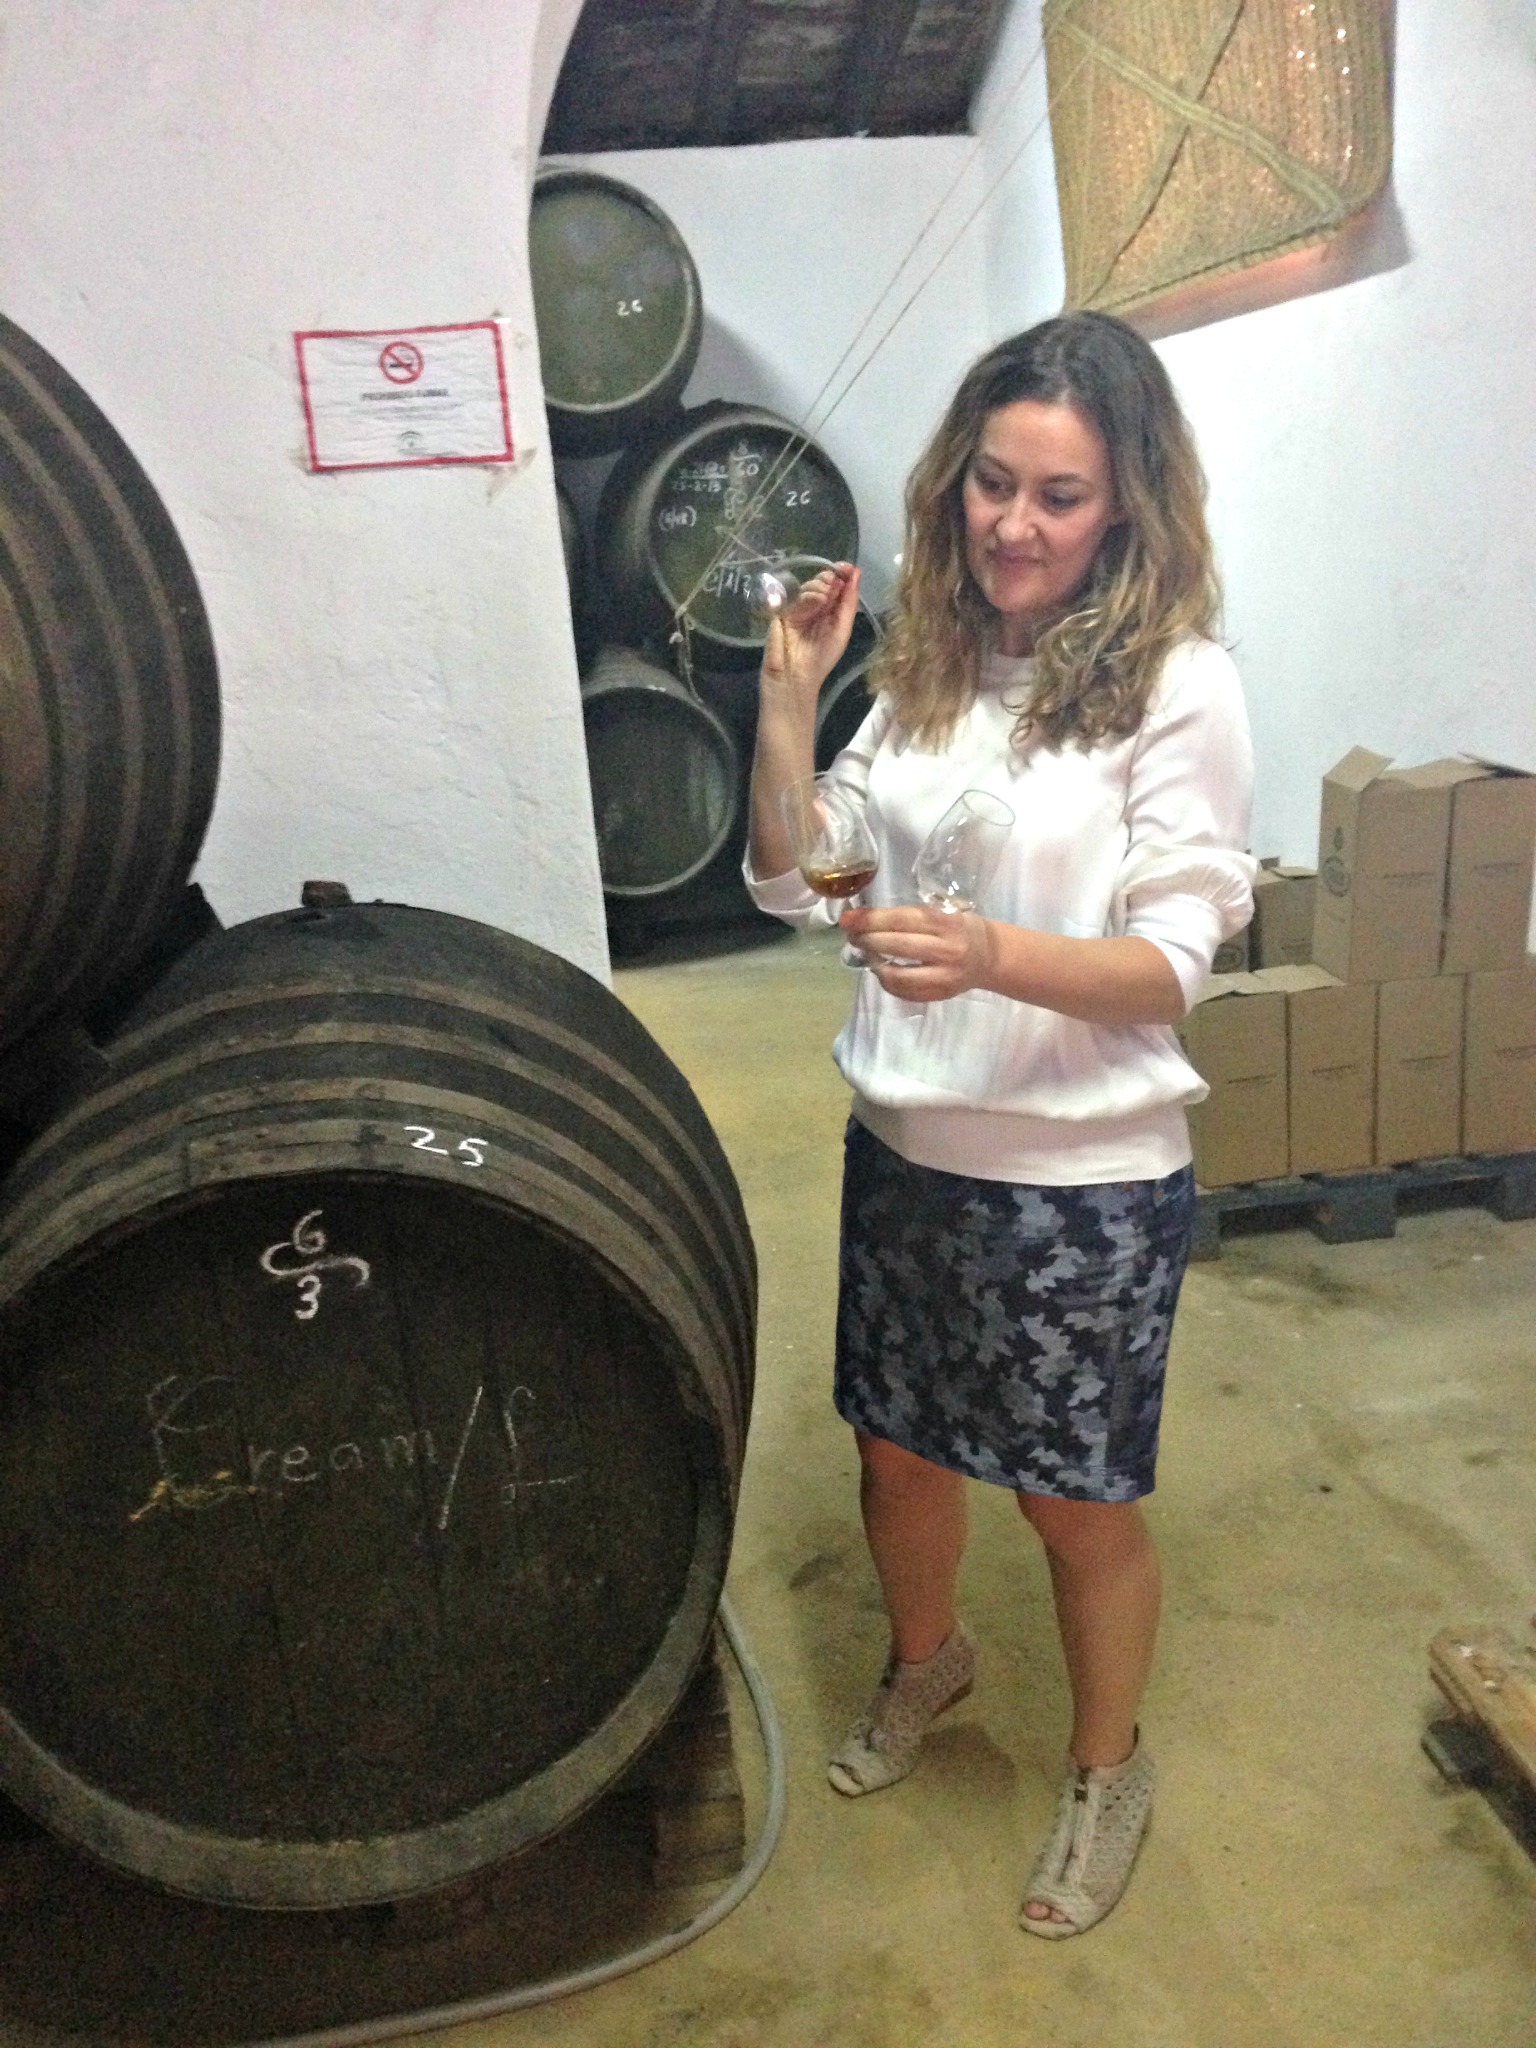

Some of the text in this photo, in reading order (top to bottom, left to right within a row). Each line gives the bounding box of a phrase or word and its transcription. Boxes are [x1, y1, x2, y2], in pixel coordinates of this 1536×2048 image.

[786, 491, 811, 507] 26
[403, 1126, 489, 1167] 25
[292, 1209, 327, 1255] 6
[294, 1274, 323, 1320] 3
